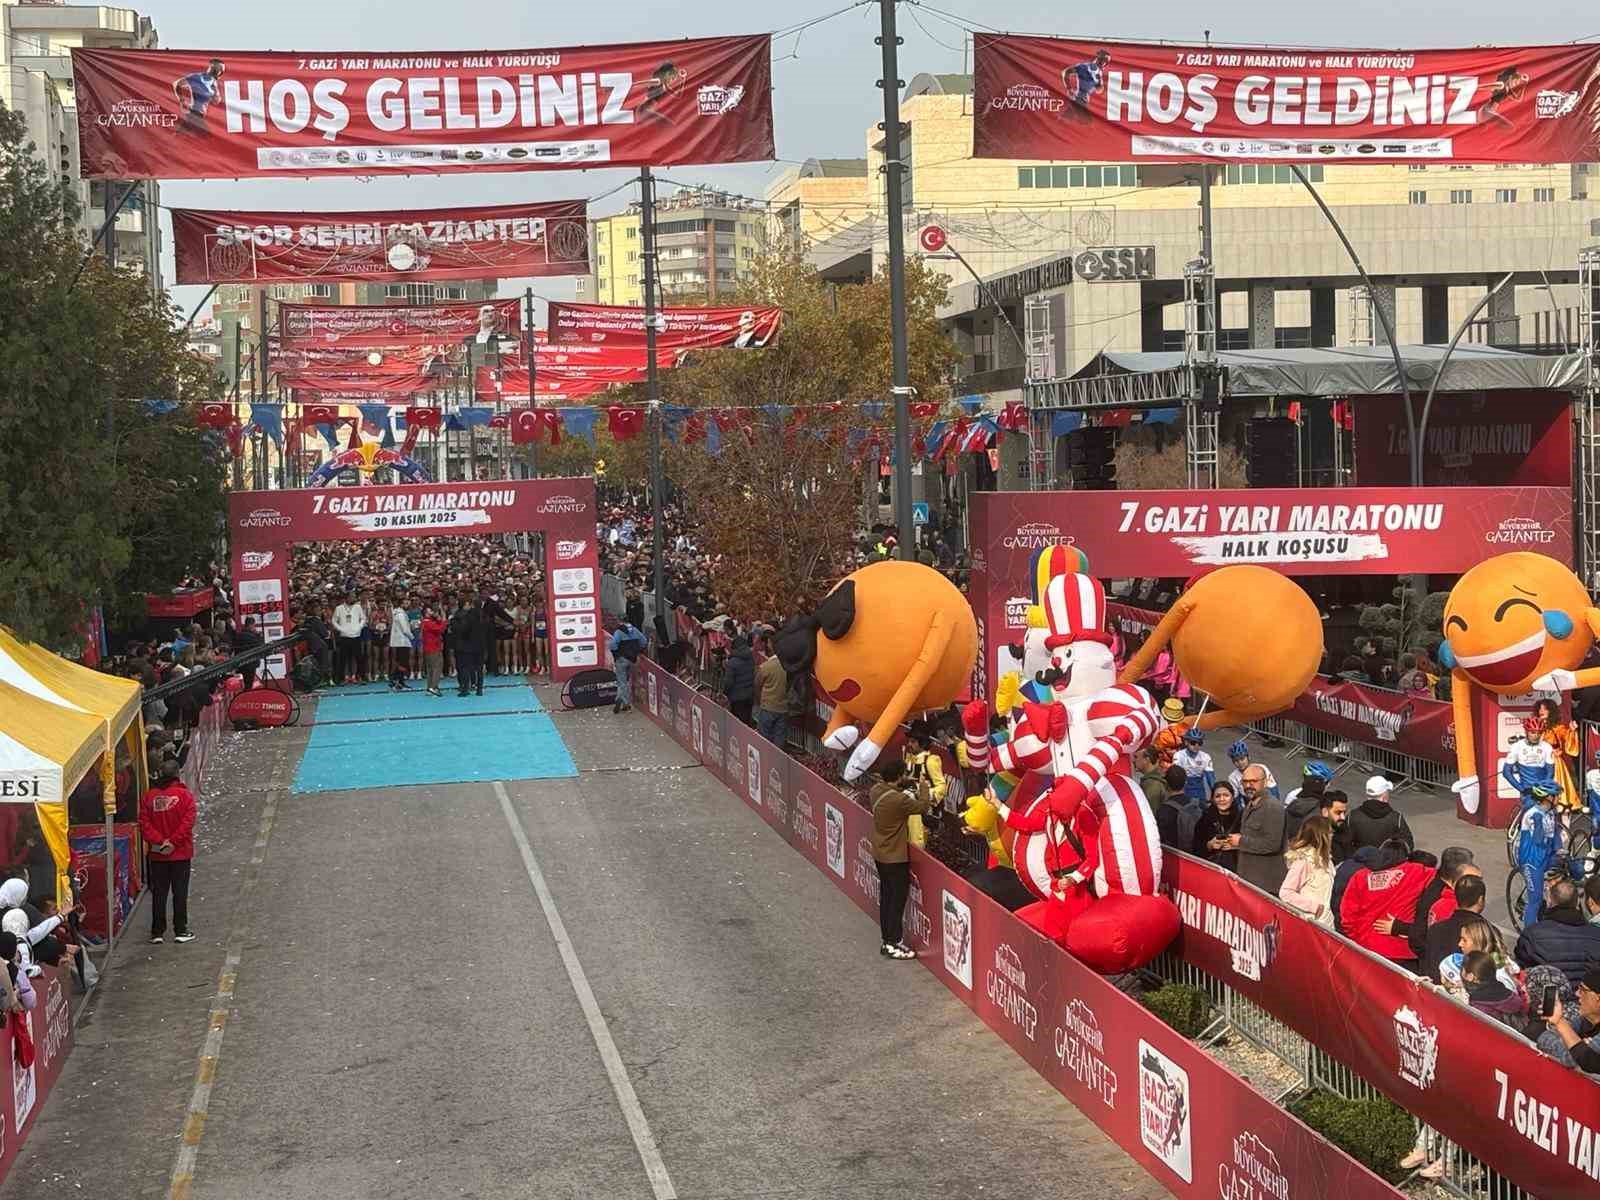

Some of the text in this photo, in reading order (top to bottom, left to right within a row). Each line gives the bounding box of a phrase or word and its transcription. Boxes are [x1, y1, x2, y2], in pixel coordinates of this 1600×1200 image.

[340, 58, 369, 70] YARI
[372, 56, 442, 70] MARATONU
[446, 60, 459, 69] ve
[463, 56, 494, 69] HALK
[1215, 55, 1241, 67] YARI
[1244, 55, 1306, 68] MARATONU
[1309, 58, 1322, 68] ve
[1325, 56, 1353, 68] HALK
[224, 78, 350, 141] HOŞ
[1105, 71, 1219, 133] HOŞ
[216, 225, 293, 247] SPOR
[374, 494, 414, 513] YARI
[419, 489, 516, 511] MARATONU
[374, 512, 457, 529] 30 KASIM 2025
[1218, 504, 1281, 532] YARI
[1288, 503, 1444, 532] MARATONU
[1222, 537, 1349, 559] HALK KOŞUSU
[0, 776, 40, 796] ESİ
[1204, 901, 1268, 968] MARATONU
[1055, 1026, 1118, 1109] GAZİANTEP
